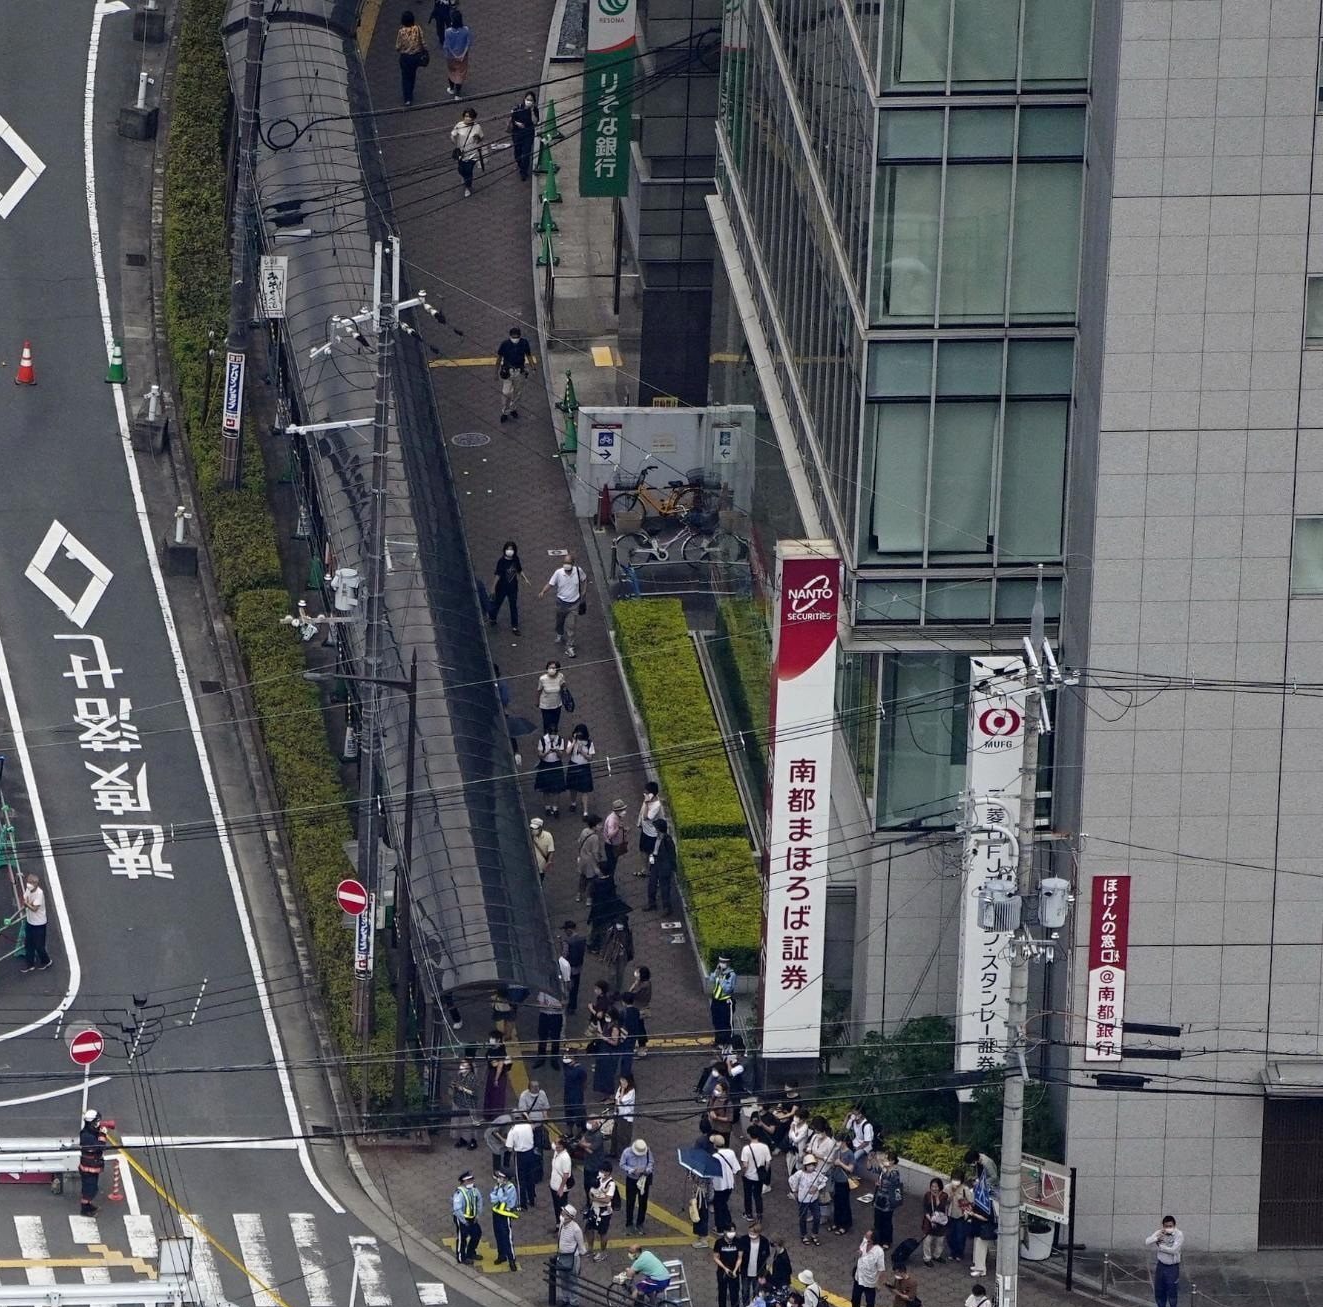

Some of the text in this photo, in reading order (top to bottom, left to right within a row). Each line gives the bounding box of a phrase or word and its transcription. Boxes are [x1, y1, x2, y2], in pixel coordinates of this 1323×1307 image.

[595, 73, 620, 178] りそな銀行
[788, 589, 833, 599] NANTO
[54, 634, 175, 880] 速度落せ
[985, 740, 1012, 749] MUFG
[781, 758, 817, 990] 南都まほろば証券
